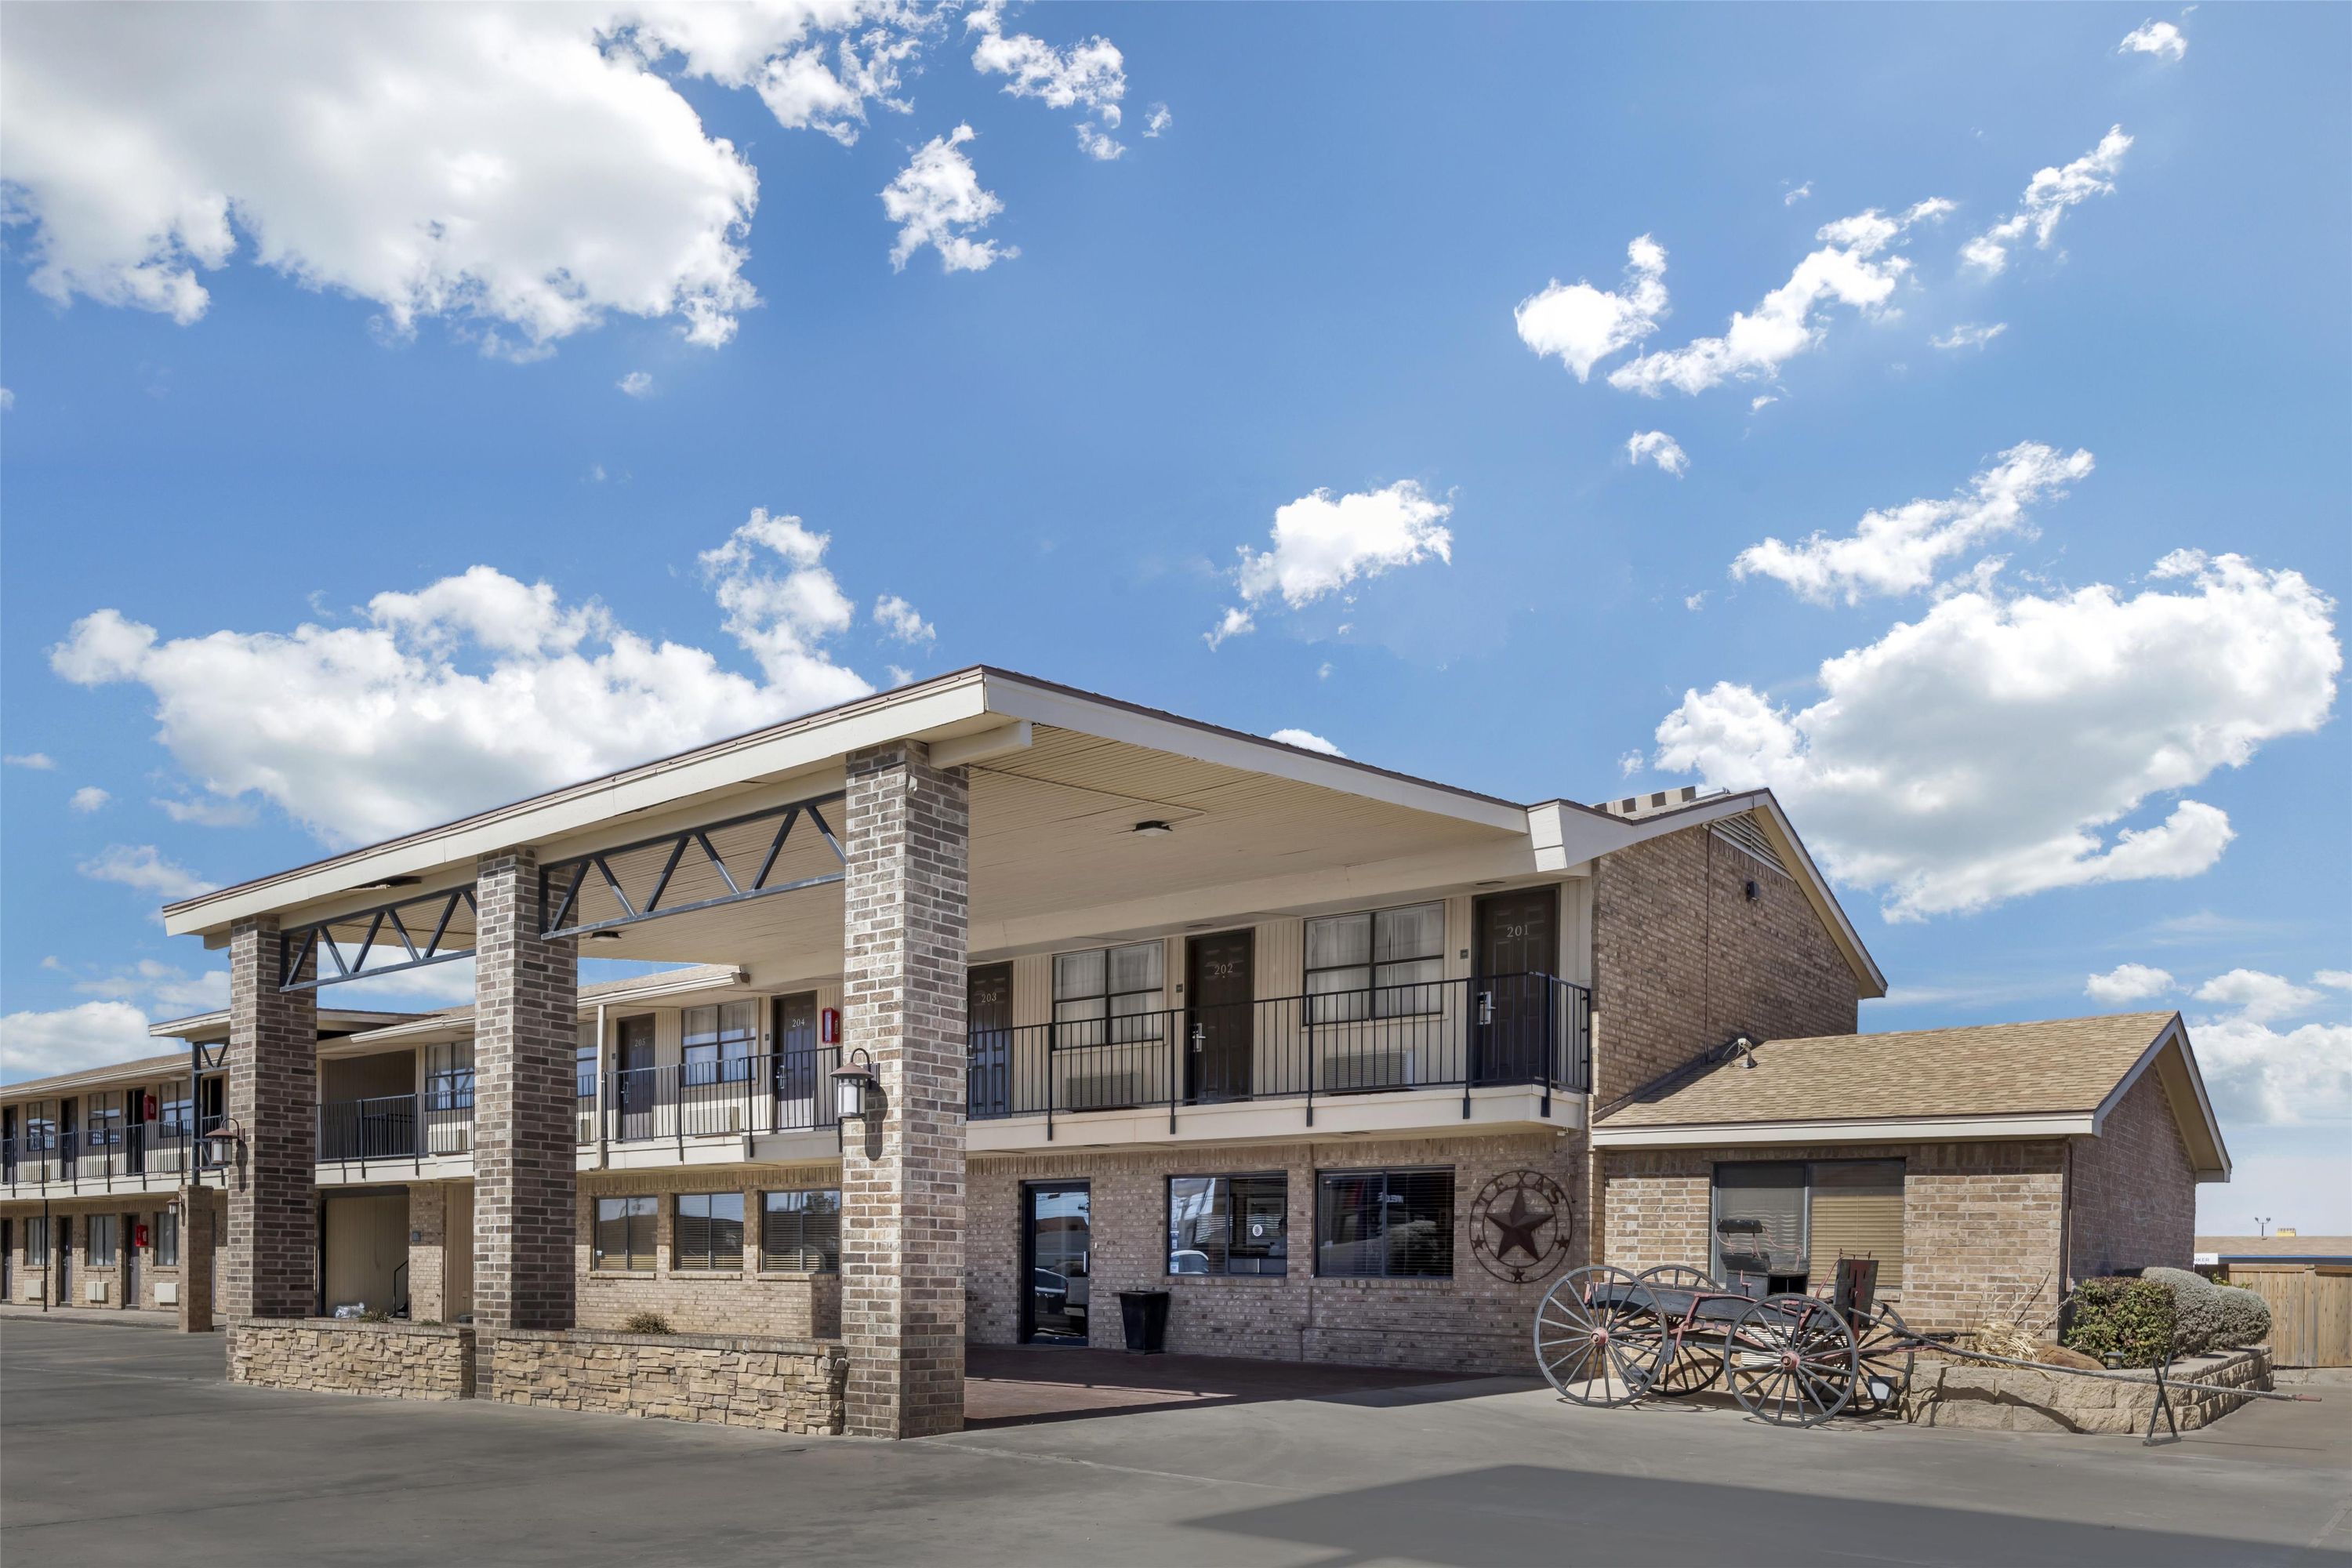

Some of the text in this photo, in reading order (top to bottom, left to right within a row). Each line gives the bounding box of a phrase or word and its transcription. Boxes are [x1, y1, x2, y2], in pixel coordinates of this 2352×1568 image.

[1507, 924, 1529, 937] 201
[1214, 963, 1233, 975] 202
[982, 992, 997, 1003] 203
[792, 1018, 805, 1027] 204
[634, 1038, 646, 1047] 205
[1475, 1171, 1565, 1207] TEXAS
